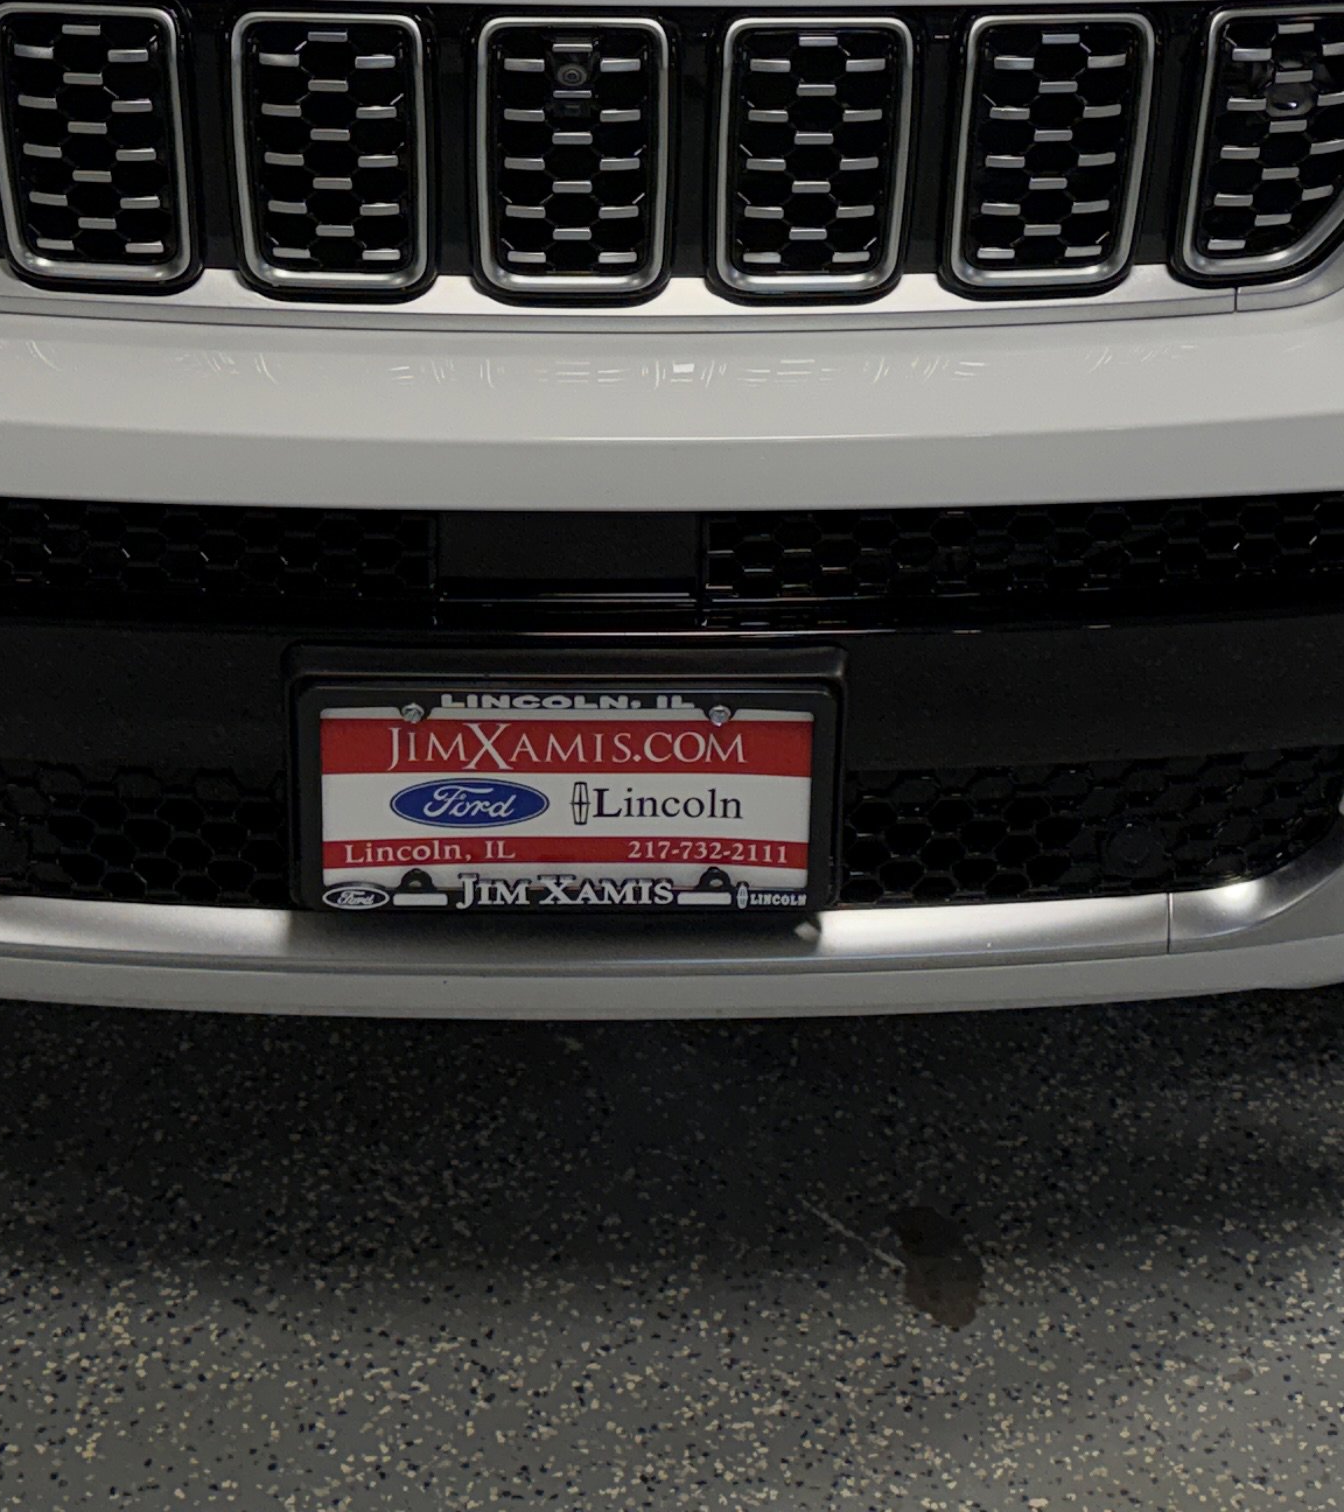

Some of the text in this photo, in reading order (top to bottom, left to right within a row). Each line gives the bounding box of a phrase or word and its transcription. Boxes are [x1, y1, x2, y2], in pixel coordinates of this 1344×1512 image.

[656, 695, 694, 710] IL
[387, 722, 748, 771] JIMXAMIS.COM
[423, 785, 516, 820] Ford
[593, 787, 743, 819] Lincoln
[344, 840, 516, 864] Lincoln, IL
[628, 840, 788, 865] 217-732-2111
[456, 875, 675, 909] JIM XAMIS
[750, 893, 807, 906] LINCOLN
